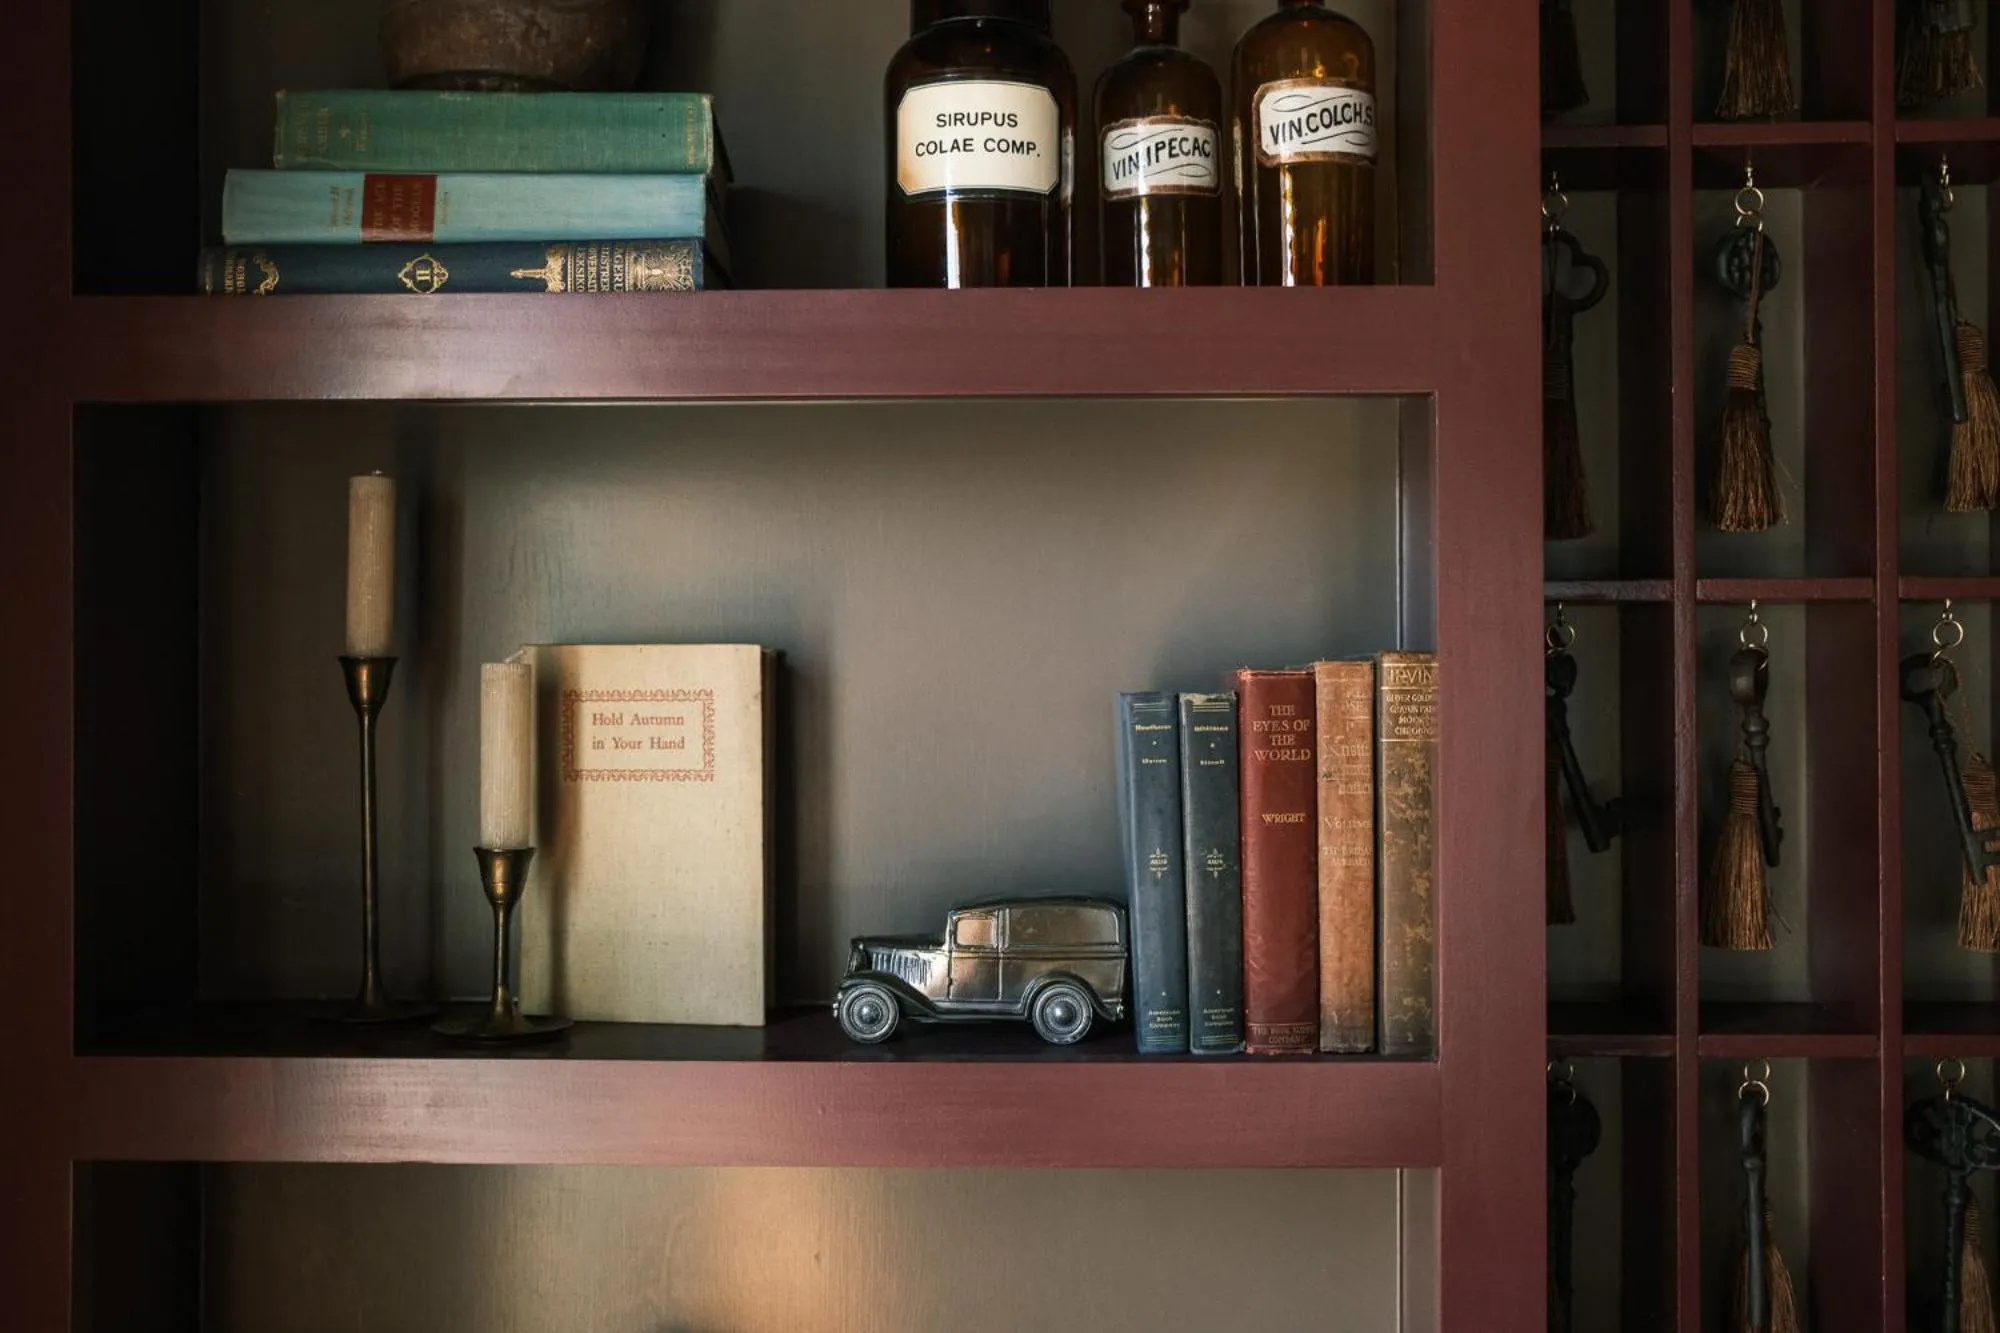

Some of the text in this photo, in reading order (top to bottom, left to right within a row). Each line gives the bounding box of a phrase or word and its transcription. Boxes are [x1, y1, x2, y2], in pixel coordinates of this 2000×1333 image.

[936, 112, 1018, 128] SIRUPUS
[915, 138, 1041, 157] COLAE COMP.
[1268, 704, 1296, 716] THE
[592, 712, 685, 727] Hold Autumn
[1253, 718, 1311, 733] EYES OF
[592, 736, 685, 750] in Your Hand
[1270, 733, 1297, 747] THE
[1253, 747, 1312, 762] WORLD
[1261, 811, 1306, 825] WRIGHT
